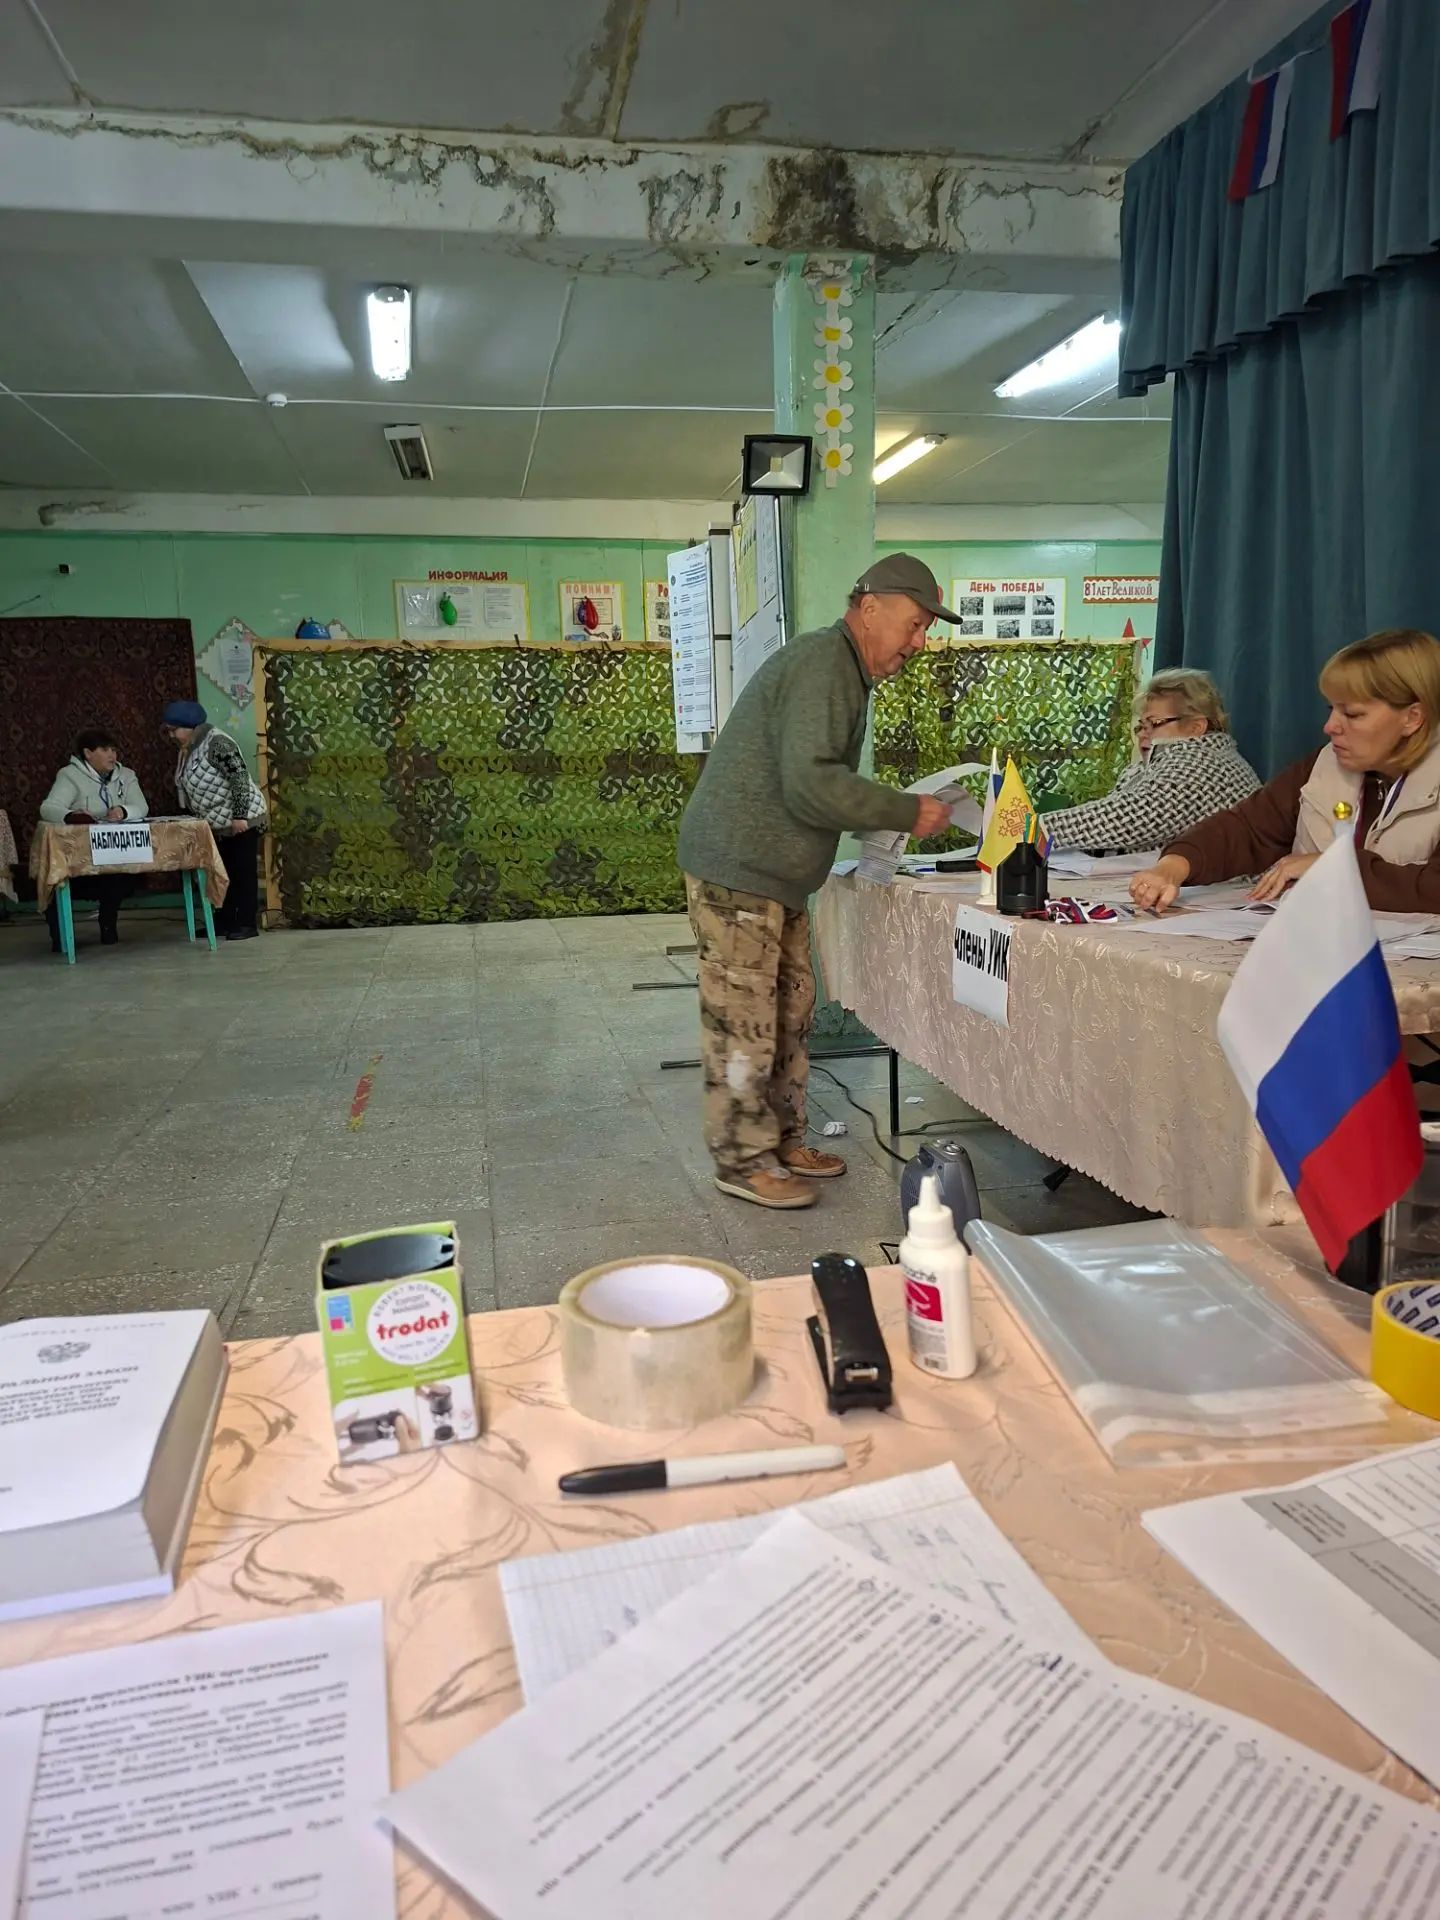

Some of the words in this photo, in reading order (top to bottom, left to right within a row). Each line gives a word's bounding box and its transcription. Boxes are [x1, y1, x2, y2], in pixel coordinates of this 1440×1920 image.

[428, 570, 508, 581] ИНФОРМАЦИЯ
[1001, 582, 1045, 593] ПОБЕДЫ
[90, 830, 152, 852] НАБЛЮДАТЕЛИ
[987, 928, 1011, 983] УИК
[376, 1310, 450, 1340] trodat
